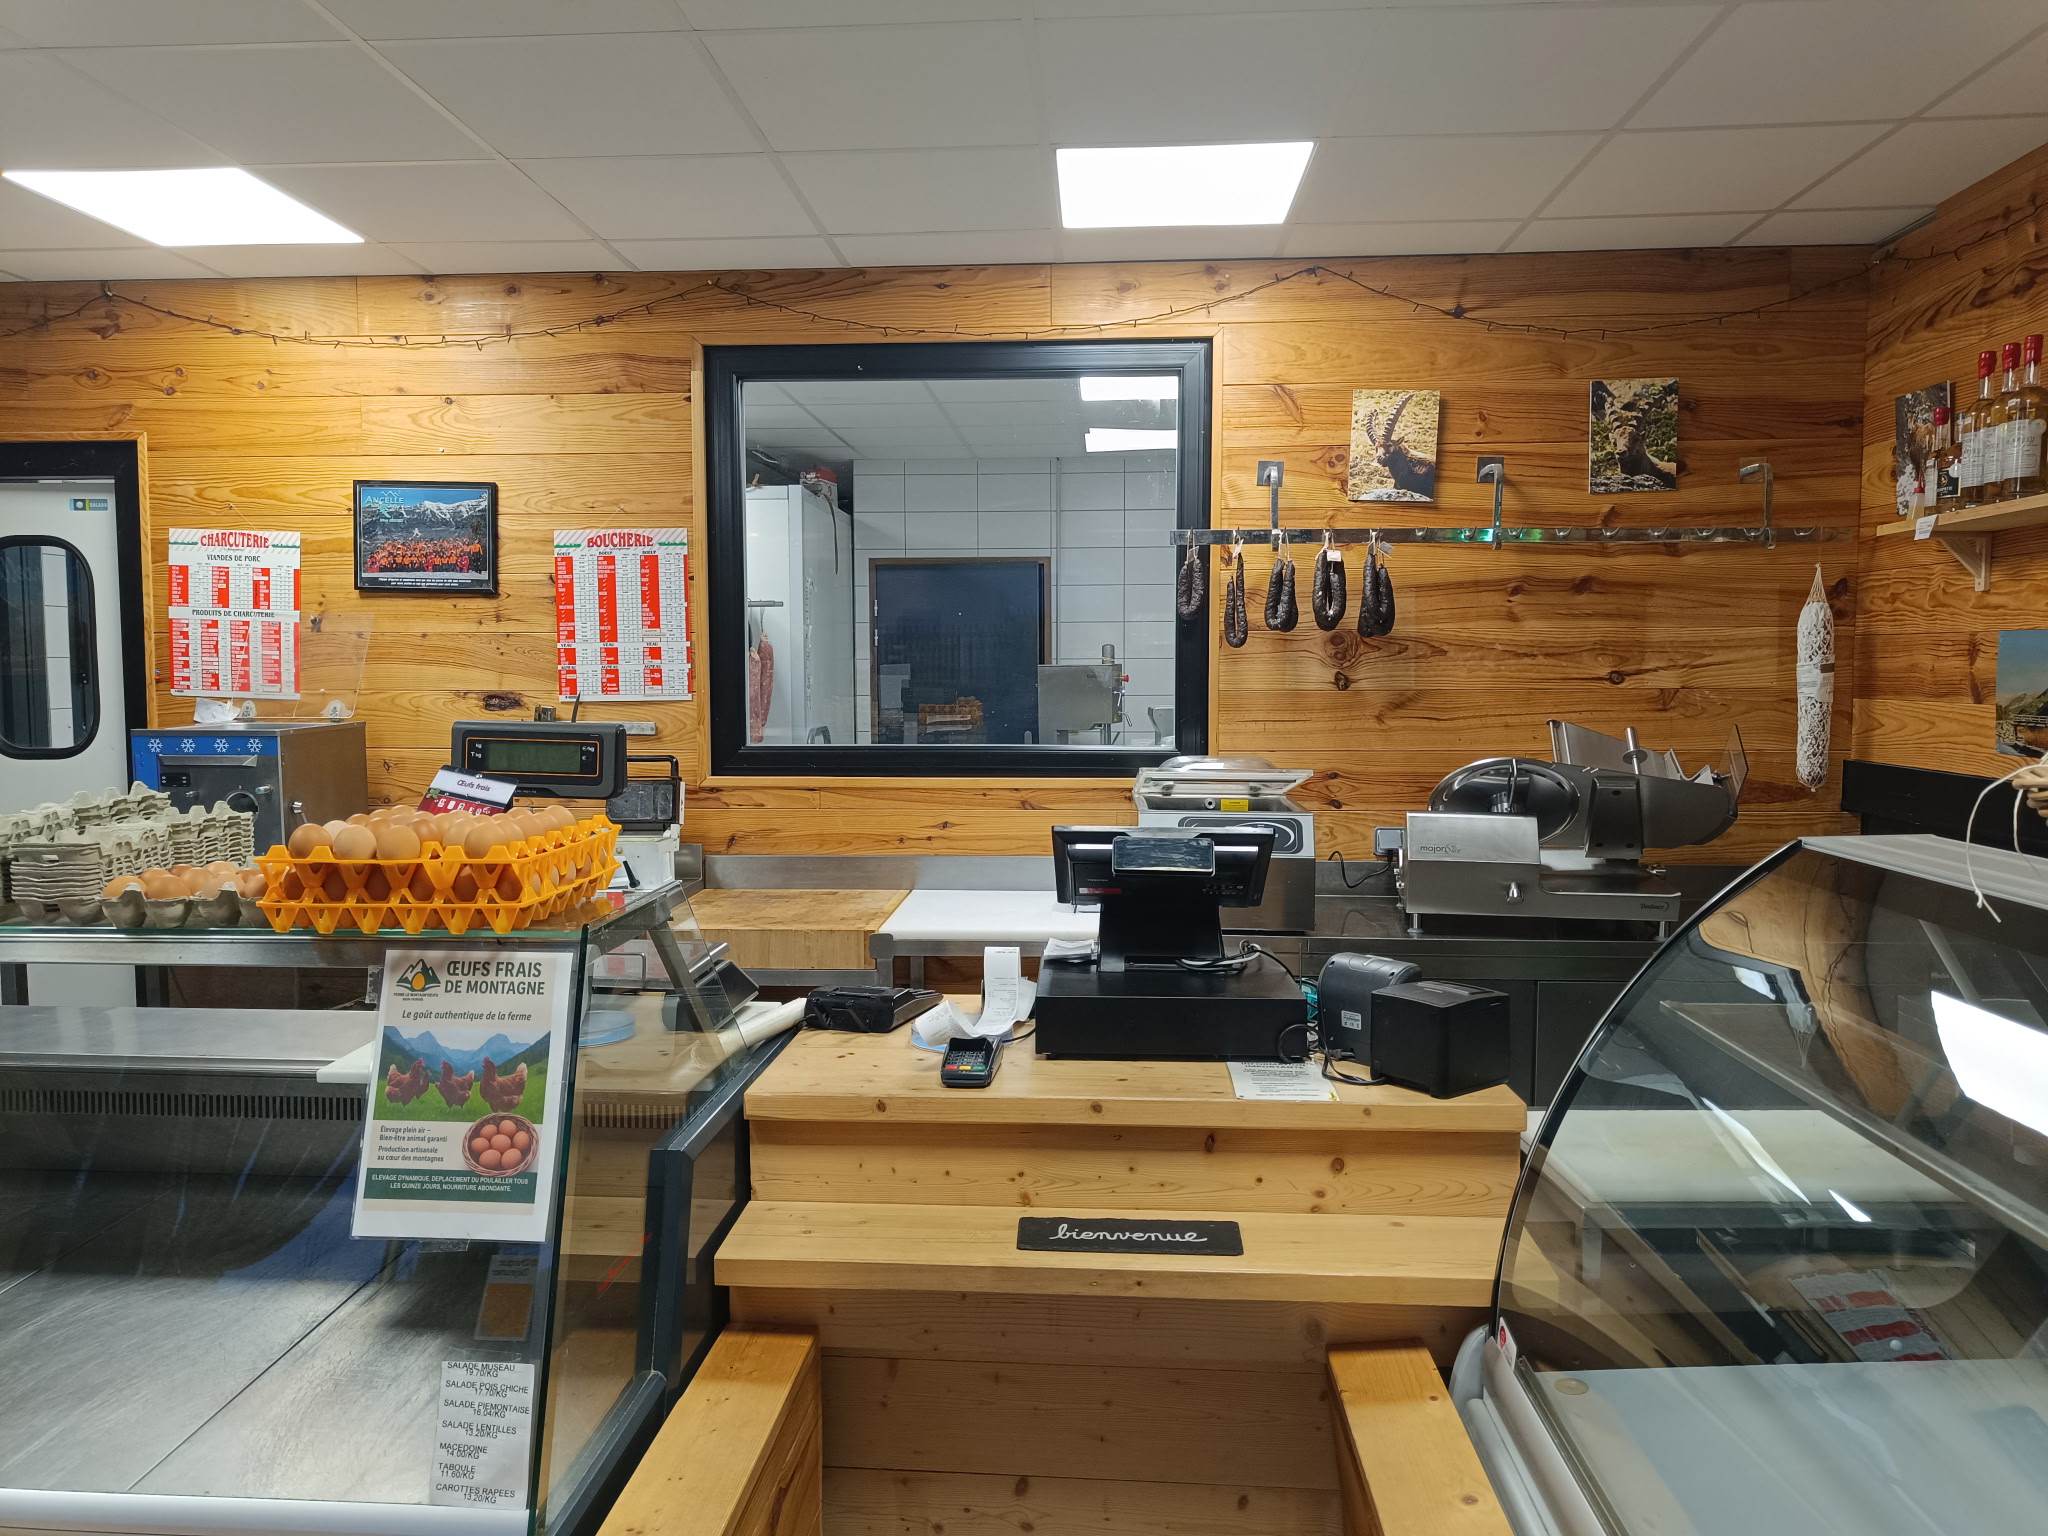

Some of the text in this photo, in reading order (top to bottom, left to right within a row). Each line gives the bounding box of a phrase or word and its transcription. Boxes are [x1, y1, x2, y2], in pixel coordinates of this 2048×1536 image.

[365, 496, 404, 504] ANCELLE
[200, 532, 270, 548] CHARCUTERIE
[586, 532, 654, 548] BOUCHERIE
[233, 610, 275, 618] CHARCUTERIE
[457, 780, 491, 791] Œufs frais
[447, 961, 542, 978] ŒUFS FRAIS
[444, 980, 545, 995] DE MONTAGNE
[402, 1009, 532, 1021] Le goût authentique de la ferme
[380, 1125, 402, 1134] Élevage
[1049, 1223, 1208, 1242] bienvenue
[466, 1369, 498, 1377] 19.70/KG
[446, 1380, 477, 1388] SALADE
[500, 1384, 528, 1393] CHICHE
[444, 1400, 530, 1414] SALADE PIEMONTAISE
[473, 1409, 506, 1418] 16.04/KG
[442, 1420, 517, 1434] SALADE LENTILLES
[465, 1429, 498, 1439] 13.20/KG
[440, 1442, 488, 1453] MACEDOINE
[438, 1463, 476, 1473] TABOULE
[436, 1484, 515, 1498] CAROTTES RAPEES
